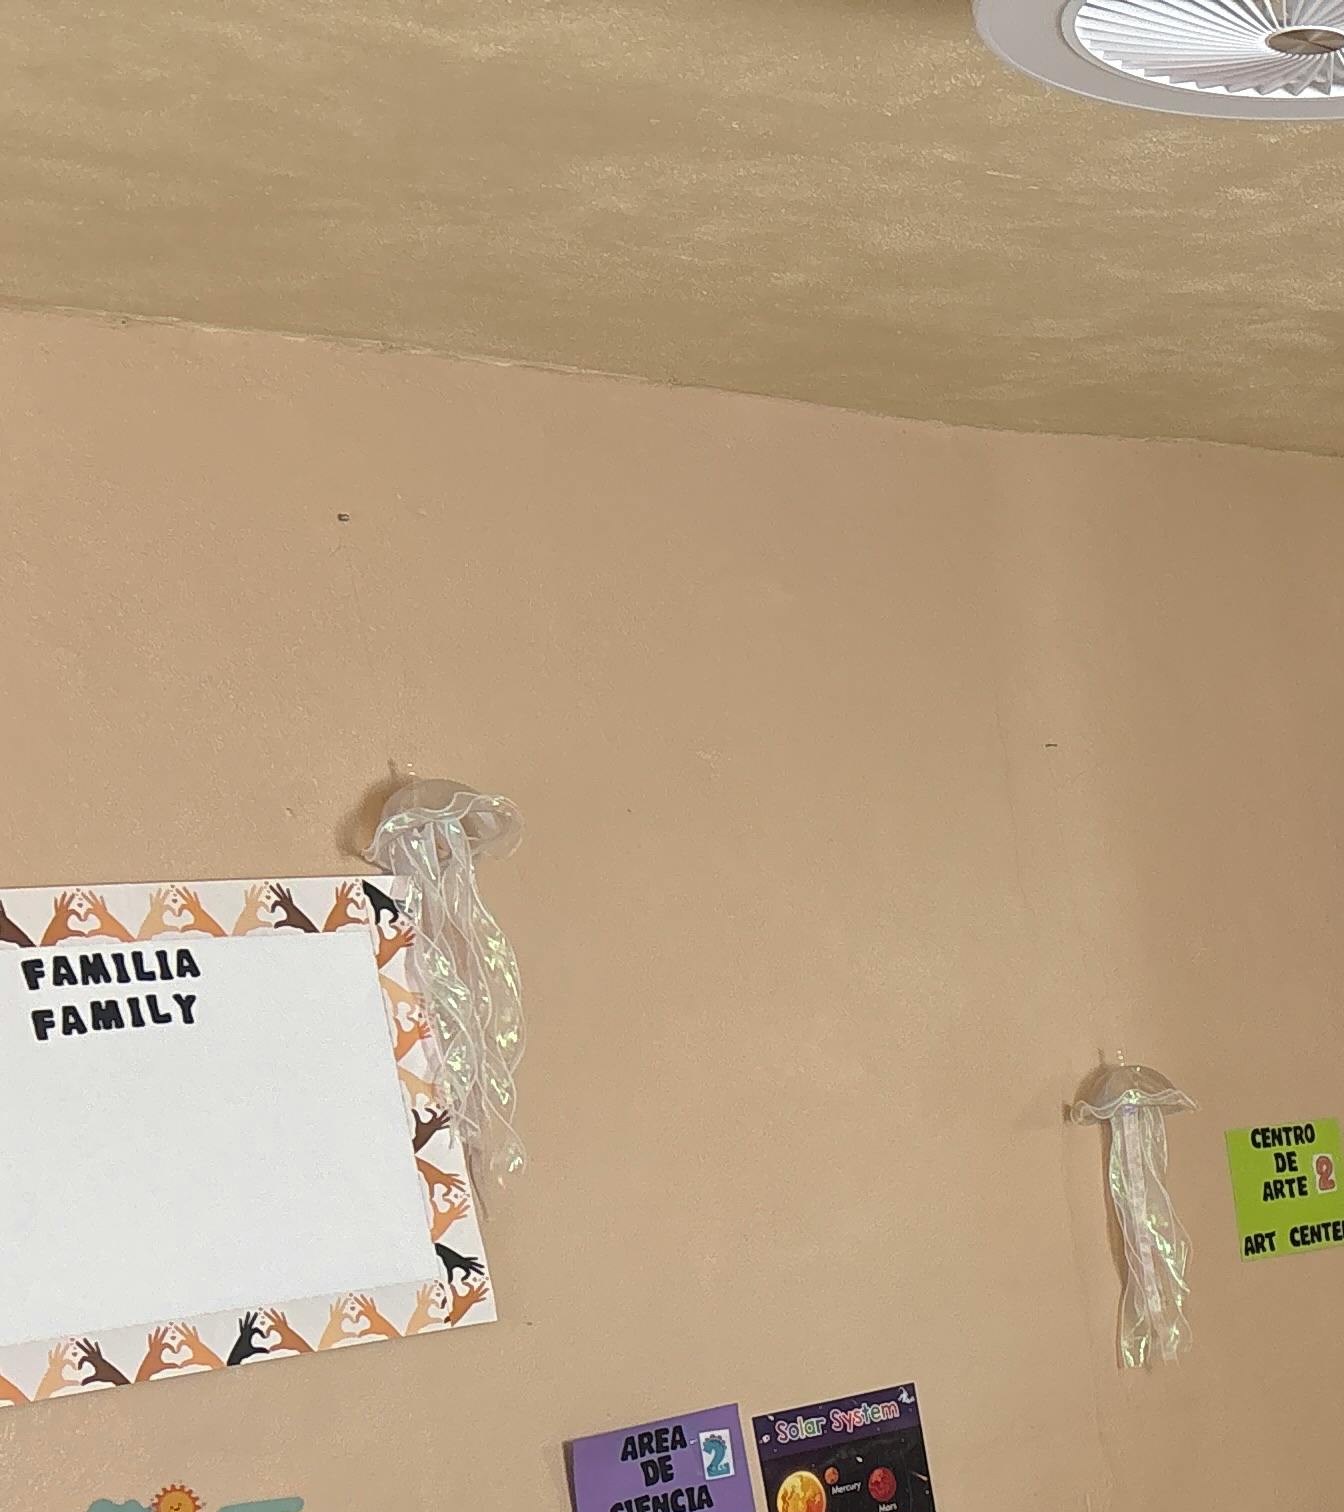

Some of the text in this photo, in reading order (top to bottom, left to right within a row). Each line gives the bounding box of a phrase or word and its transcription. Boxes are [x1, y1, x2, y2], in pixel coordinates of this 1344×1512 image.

[21, 948, 201, 991] FAMILIA
[31, 994, 198, 1040] FAMILY
[1250, 1123, 1316, 1149] CENTRO
[1273, 1151, 1299, 1173] DE
[1315, 1155, 1336, 1191] 2
[1262, 1176, 1308, 1202] ARTE
[1244, 1231, 1276, 1256] ART
[775, 1401, 900, 1444] Solar System
[620, 1425, 687, 1463] AREA
[702, 1434, 731, 1478] 2
[640, 1454, 675, 1487] DE
[831, 1481, 862, 1495] Mercury
[879, 1502, 898, 1512] Mars
